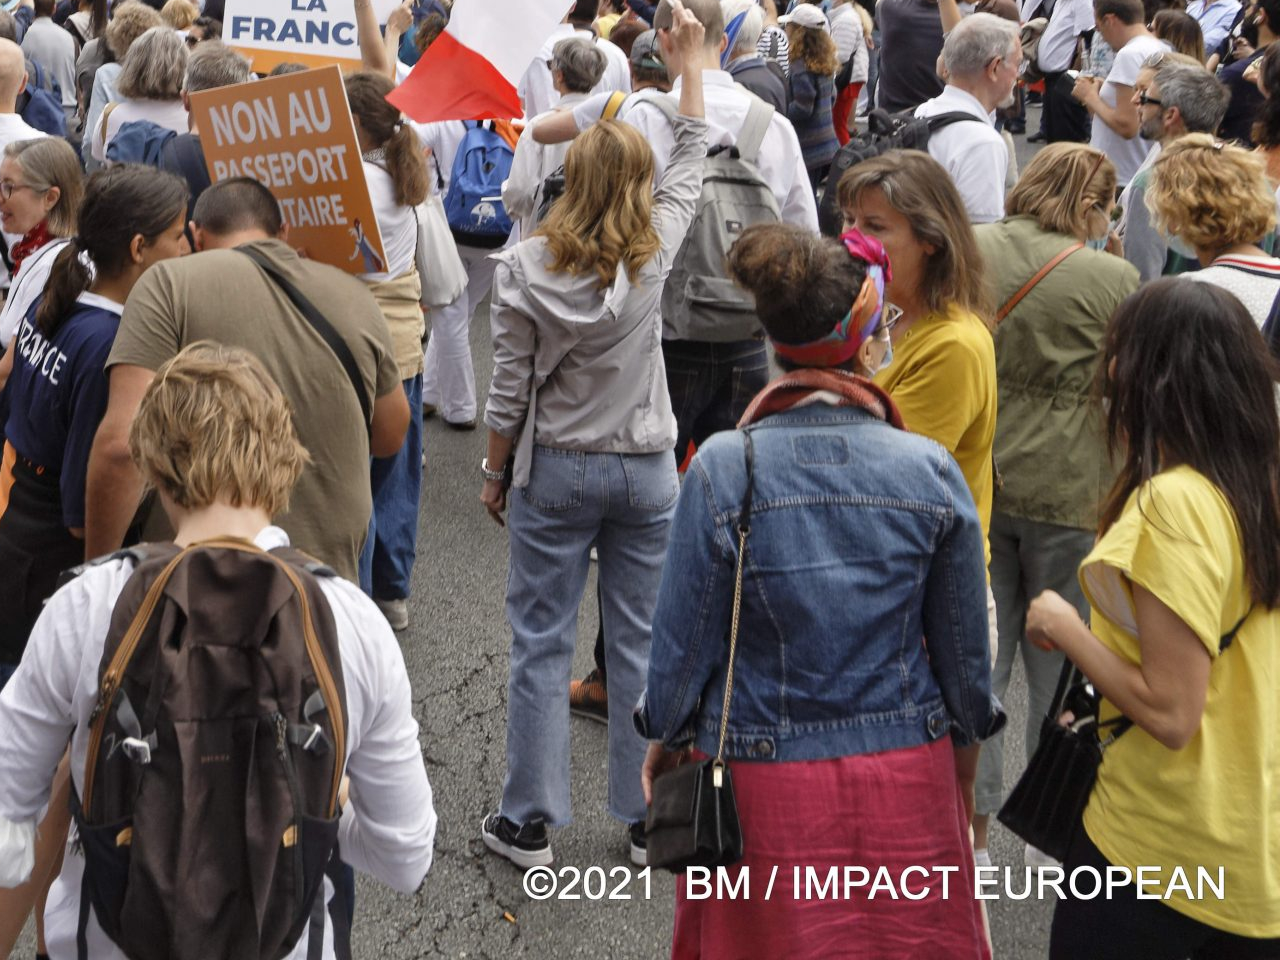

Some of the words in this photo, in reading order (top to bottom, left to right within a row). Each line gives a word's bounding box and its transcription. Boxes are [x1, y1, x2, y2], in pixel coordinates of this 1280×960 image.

[208, 96, 282, 147] NON
[288, 87, 332, 137] AU
[280, 194, 348, 228] ITAIRE
